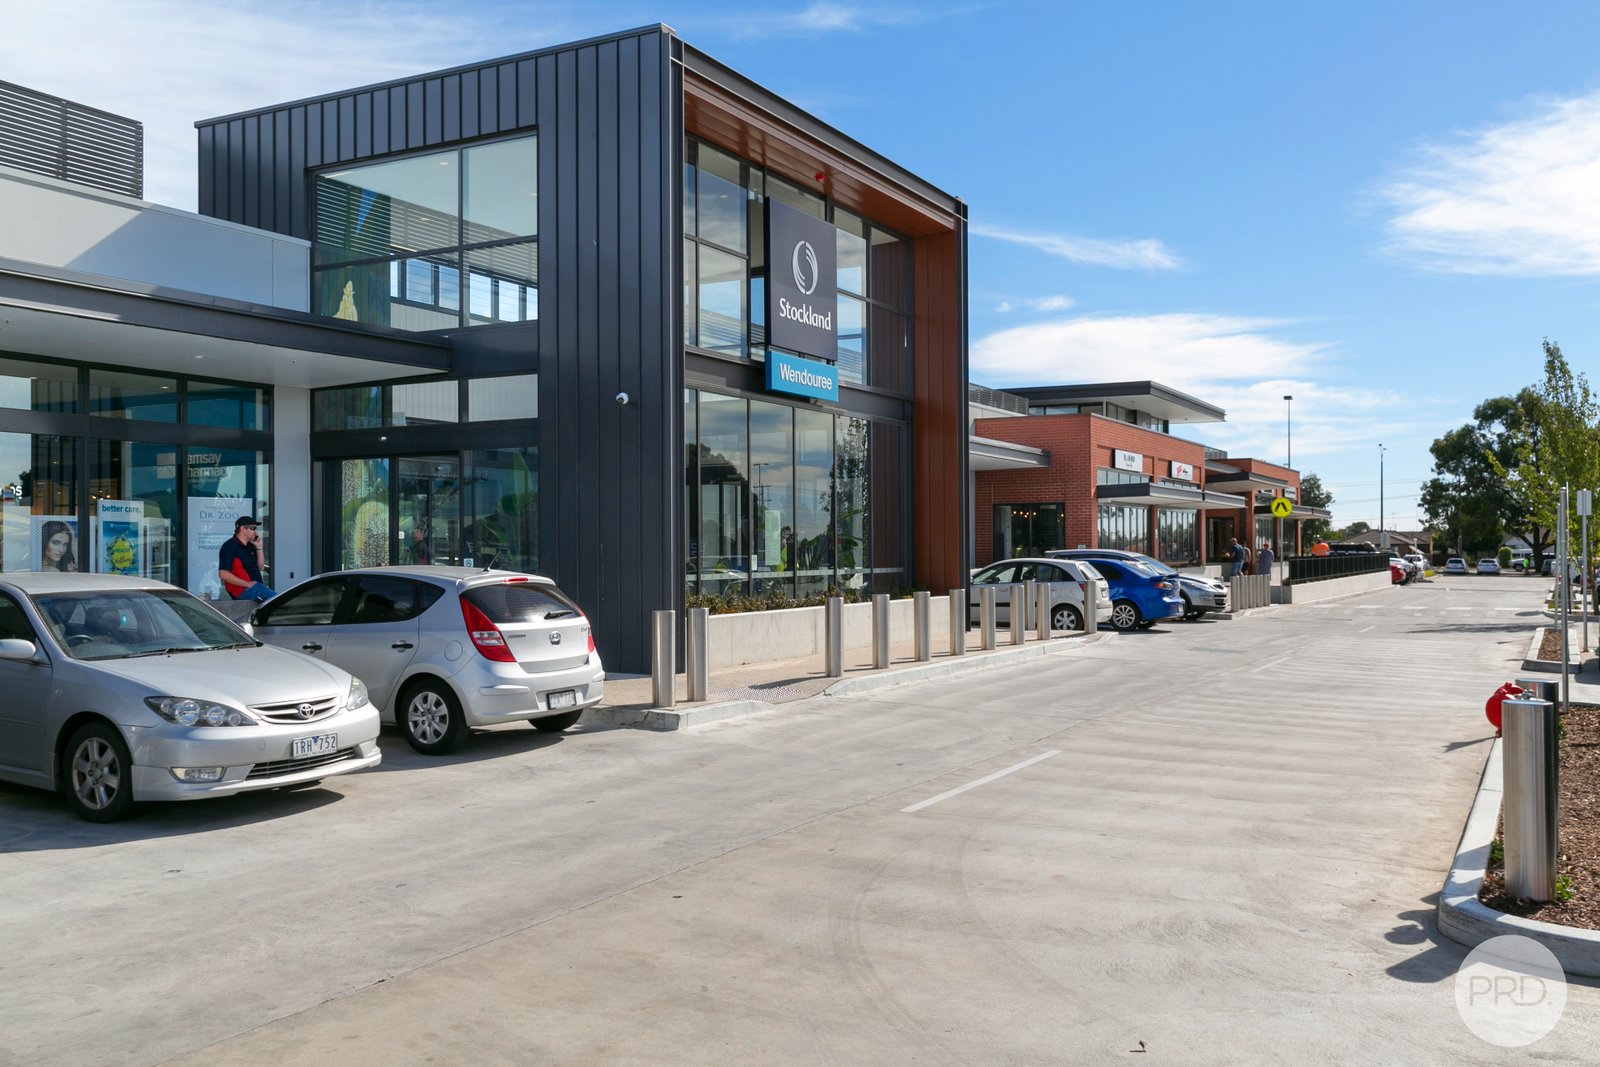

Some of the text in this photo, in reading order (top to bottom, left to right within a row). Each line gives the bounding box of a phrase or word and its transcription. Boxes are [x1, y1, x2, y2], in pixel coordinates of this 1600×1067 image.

[779, 297, 832, 331] Stockland
[779, 363, 833, 390] Wendouree
[187, 453, 222, 466] amsay
[102, 504, 123, 513] better
